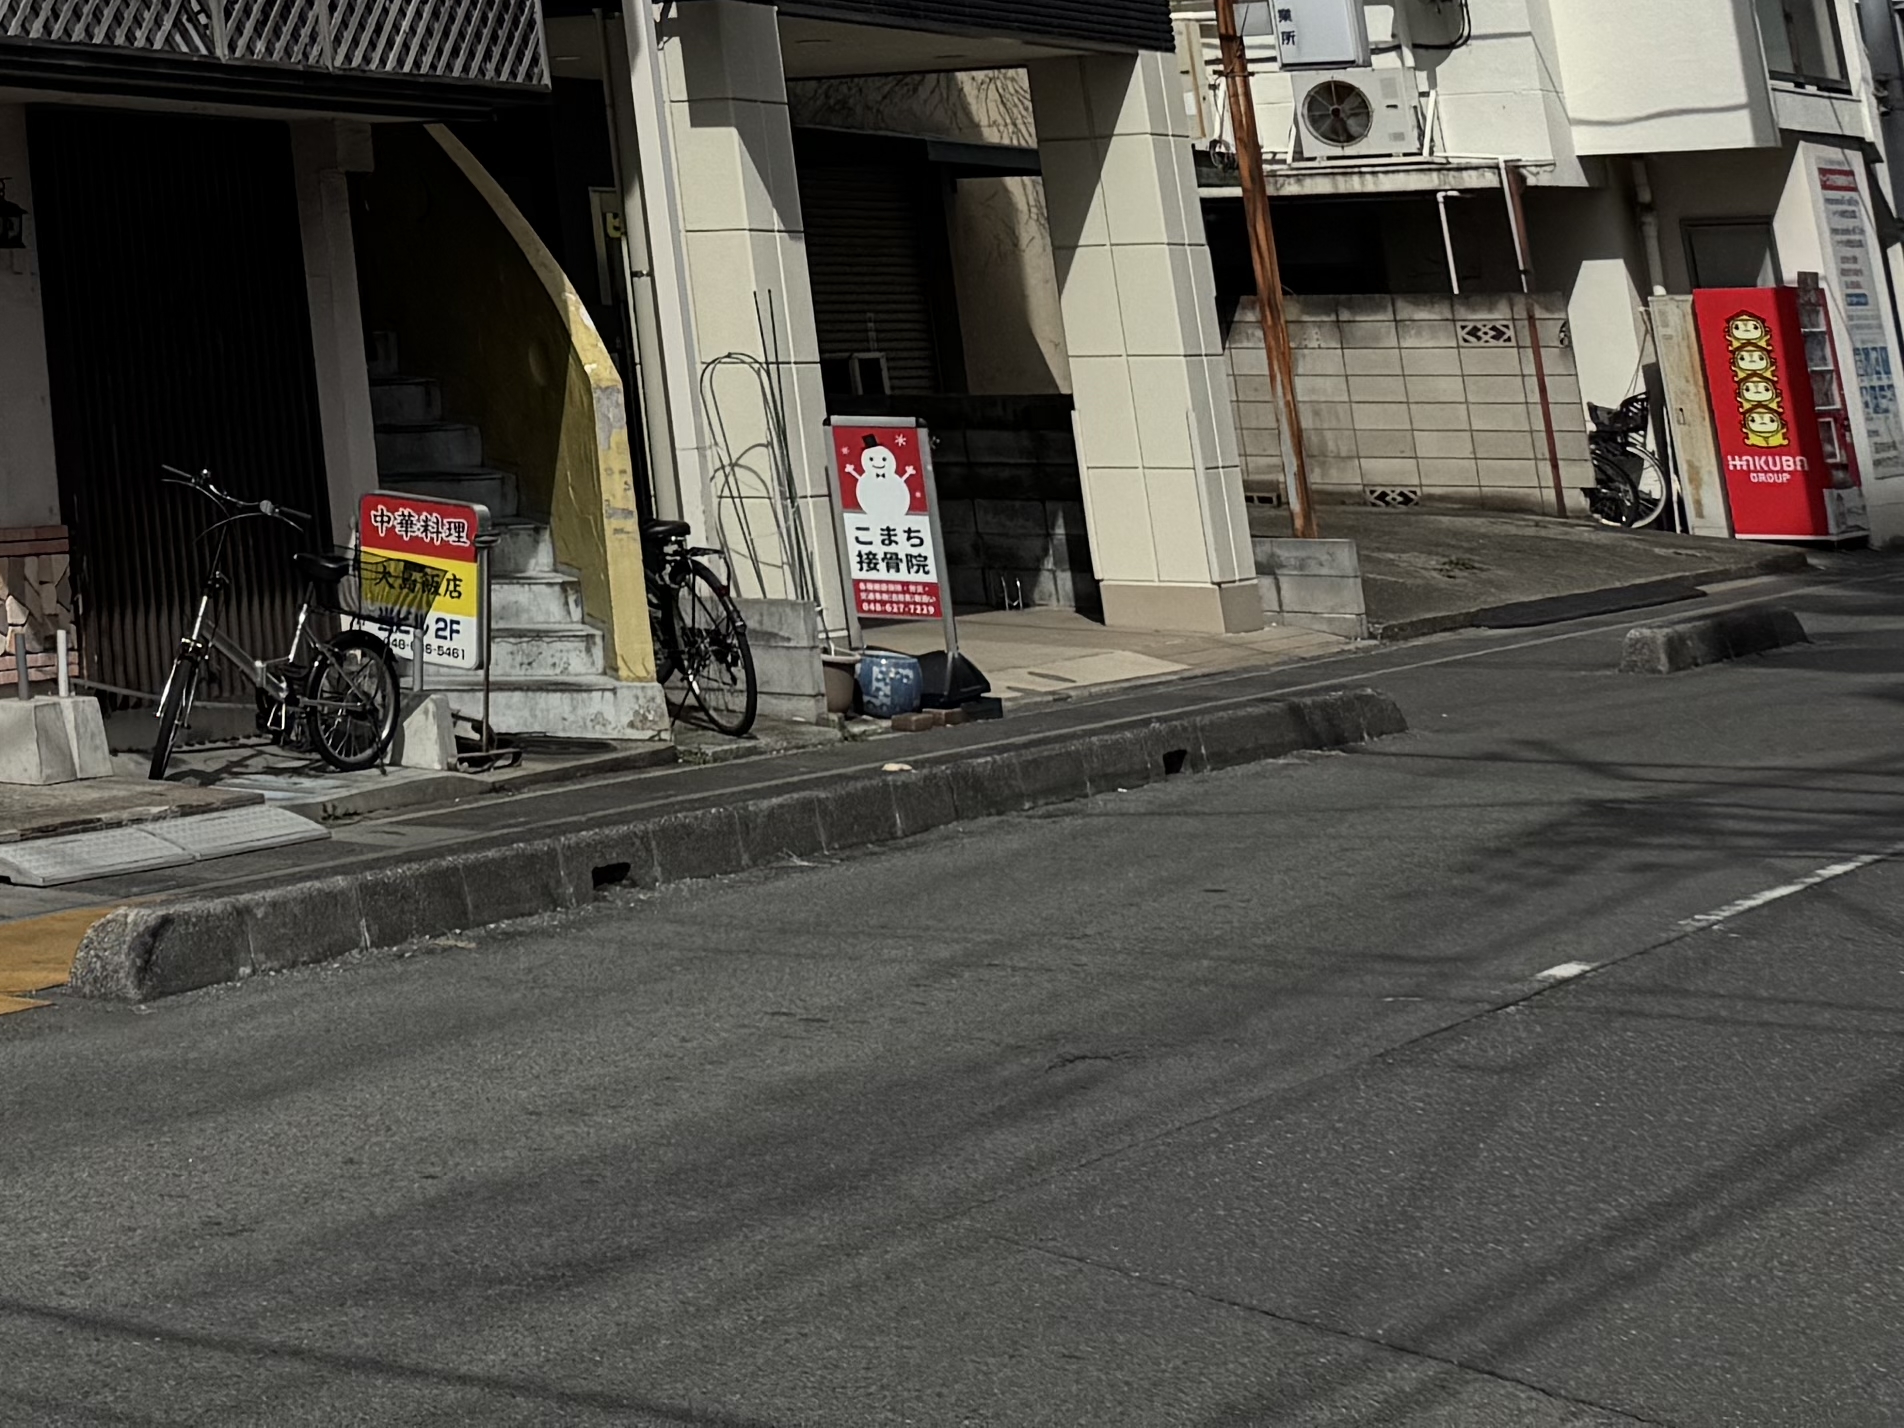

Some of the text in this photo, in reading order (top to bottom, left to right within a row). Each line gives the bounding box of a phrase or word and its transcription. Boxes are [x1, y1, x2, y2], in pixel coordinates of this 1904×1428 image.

[1750, 473, 1791, 483] GROUP
[370, 504, 470, 546] 中華料理
[855, 526, 924, 548] こまち
[856, 550, 930, 575] 接骨院
[434, 617, 461, 642] 2F
